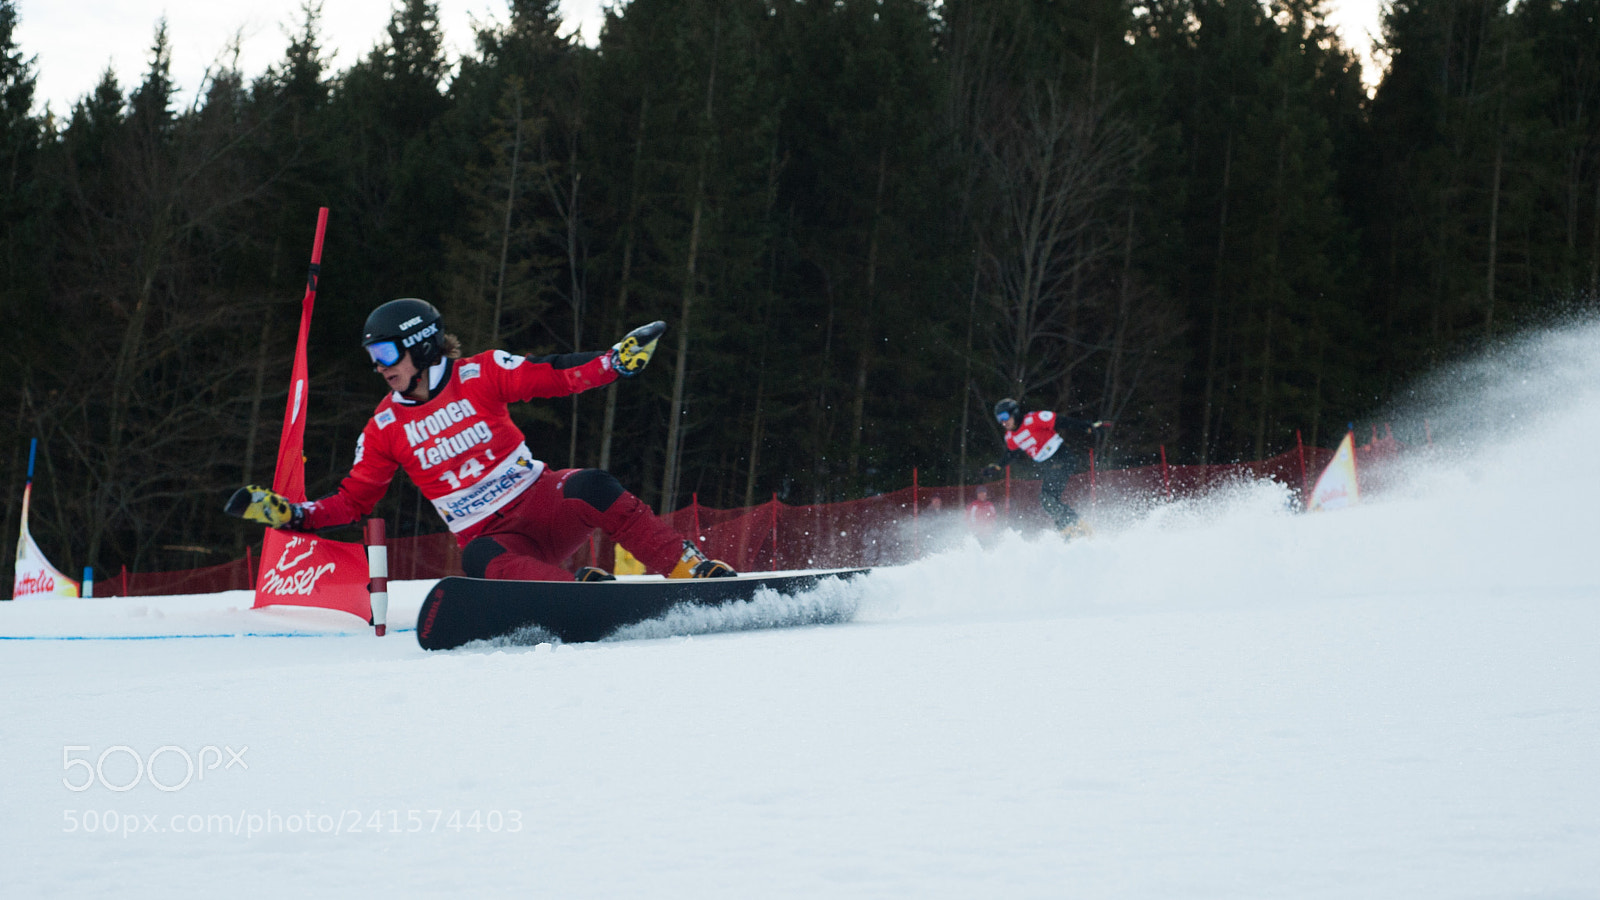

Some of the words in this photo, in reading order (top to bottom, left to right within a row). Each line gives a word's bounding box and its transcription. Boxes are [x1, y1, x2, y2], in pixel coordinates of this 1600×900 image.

[399, 316, 423, 331] uvex
[402, 323, 438, 348] uvex
[403, 399, 477, 447] Kronen
[413, 421, 493, 470] Zeitung
